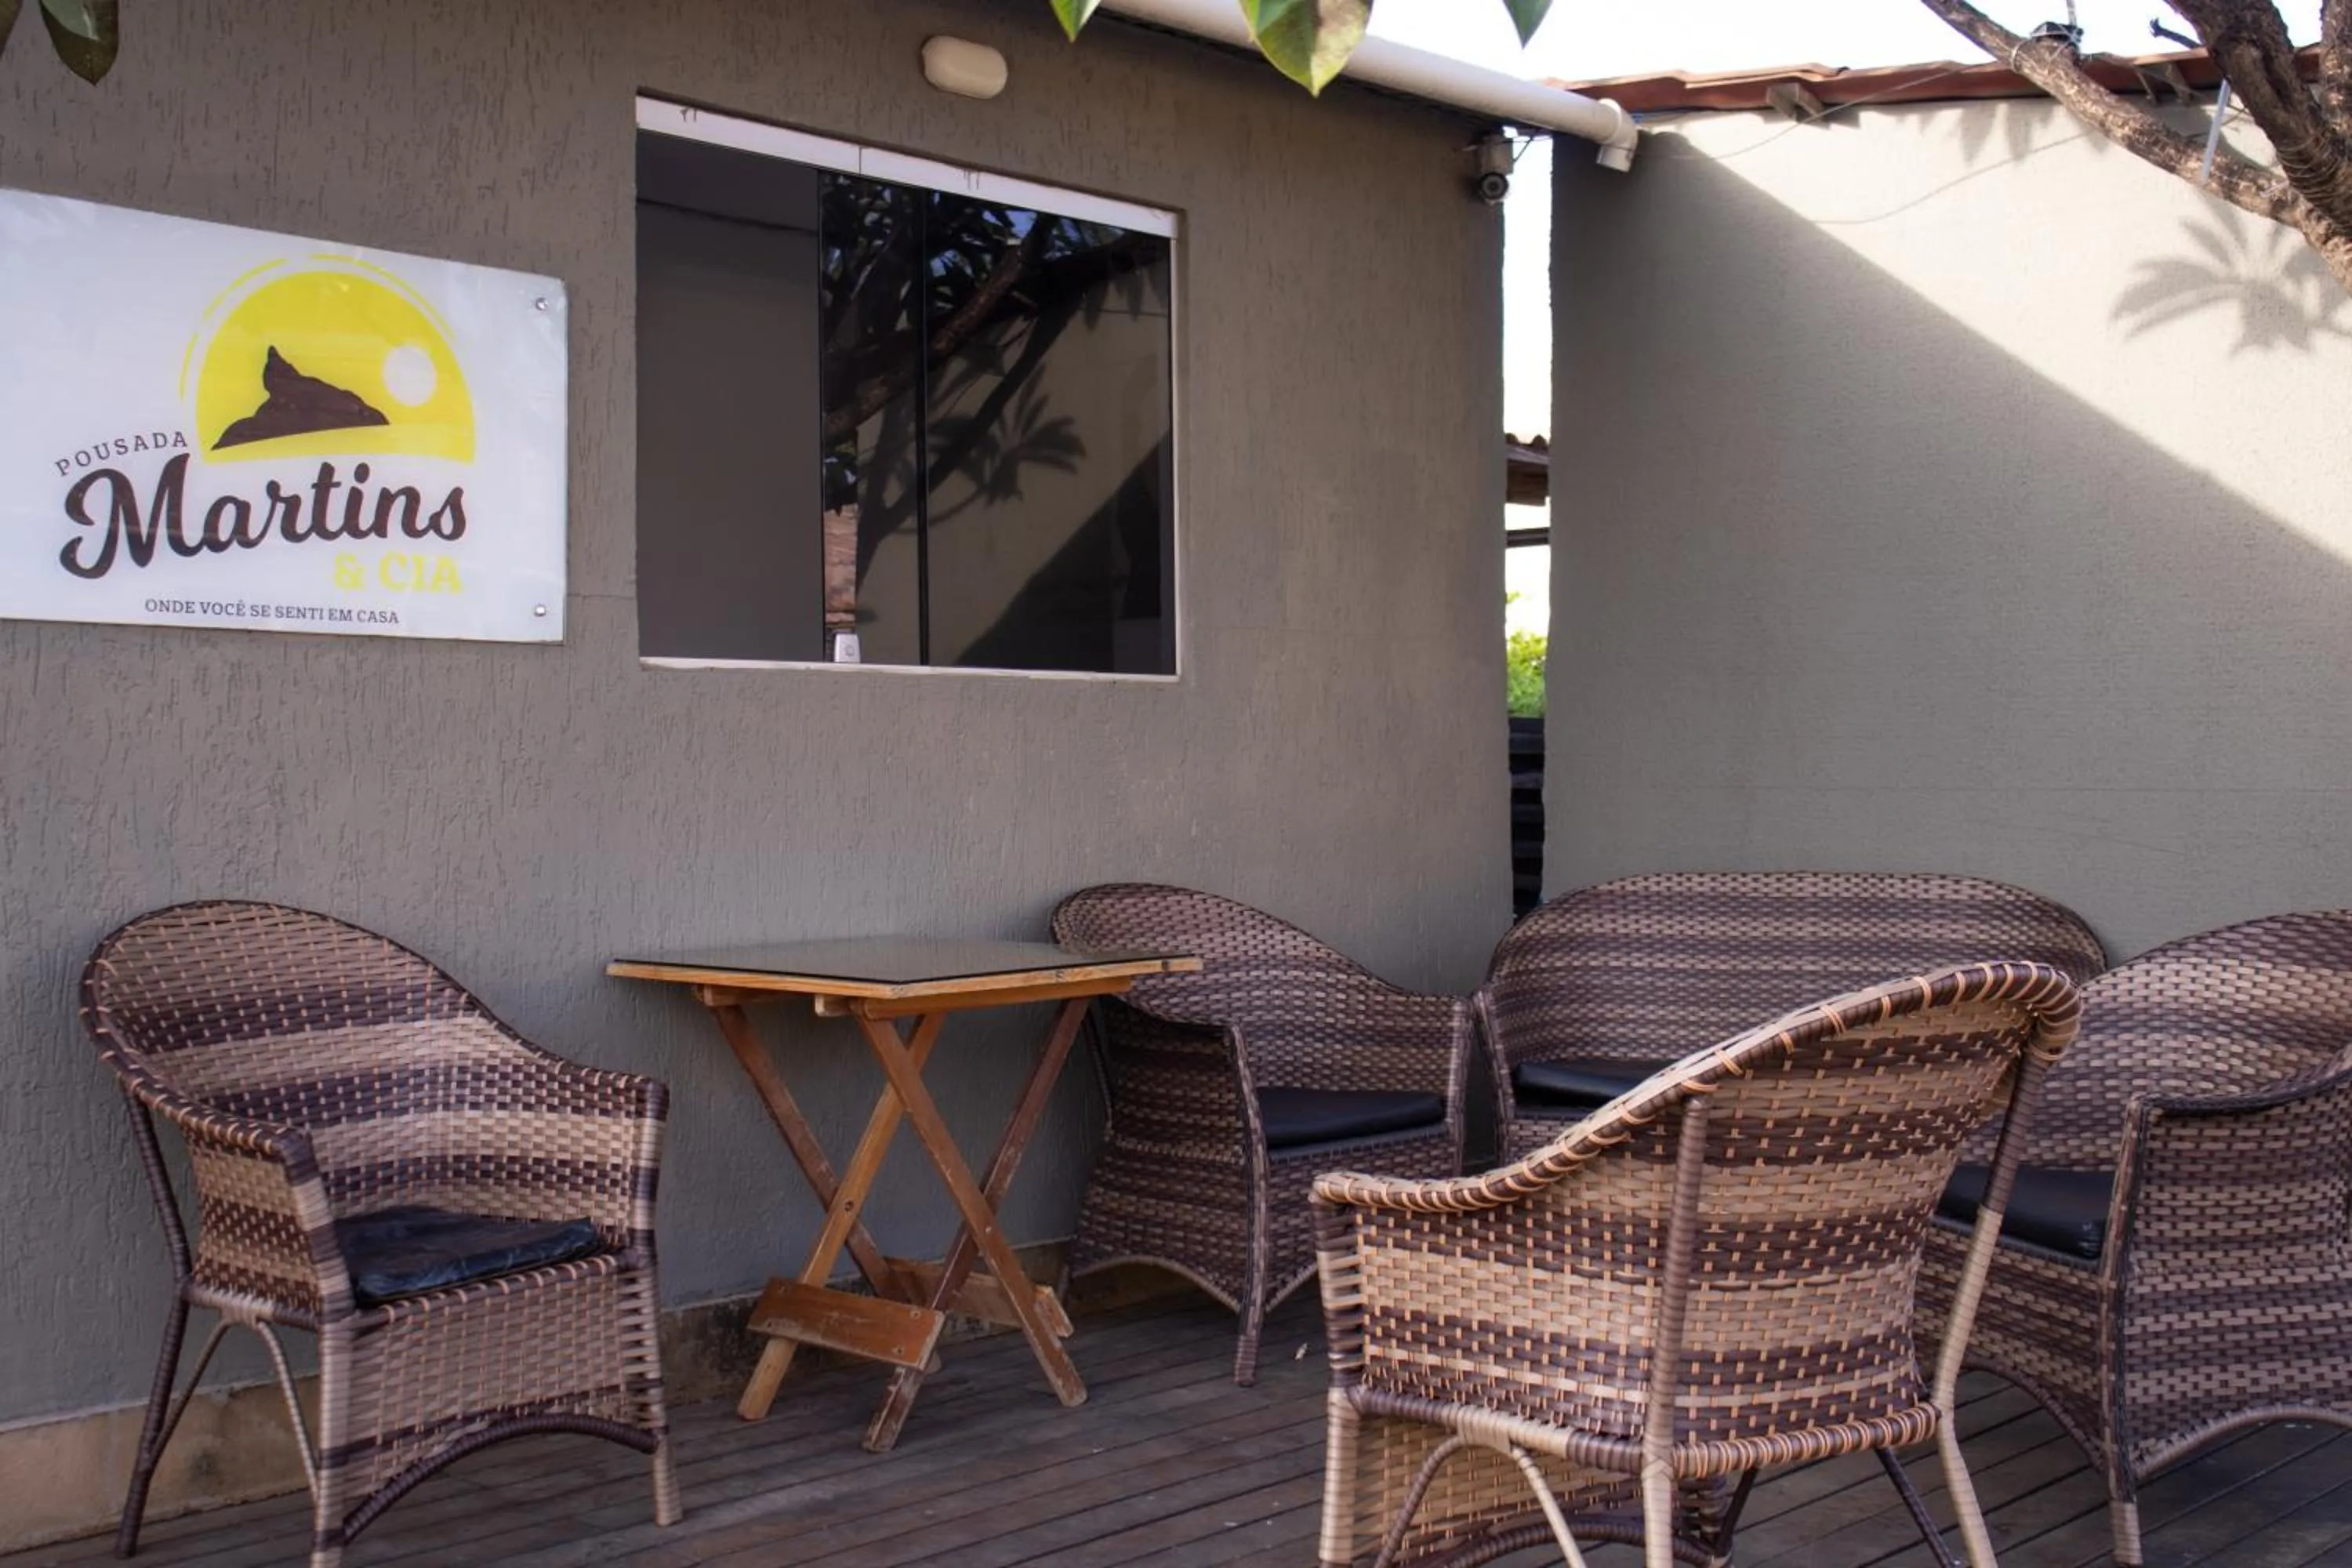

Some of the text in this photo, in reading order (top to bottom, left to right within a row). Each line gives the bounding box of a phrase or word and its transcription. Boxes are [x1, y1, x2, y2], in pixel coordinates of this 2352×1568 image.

[54, 431, 188, 477] POUSADA
[59, 452, 467, 579] Martins
[334, 551, 463, 593] & CIA
[144, 598, 400, 623] ONDE VOCÊ SE SENTI EM CASA
